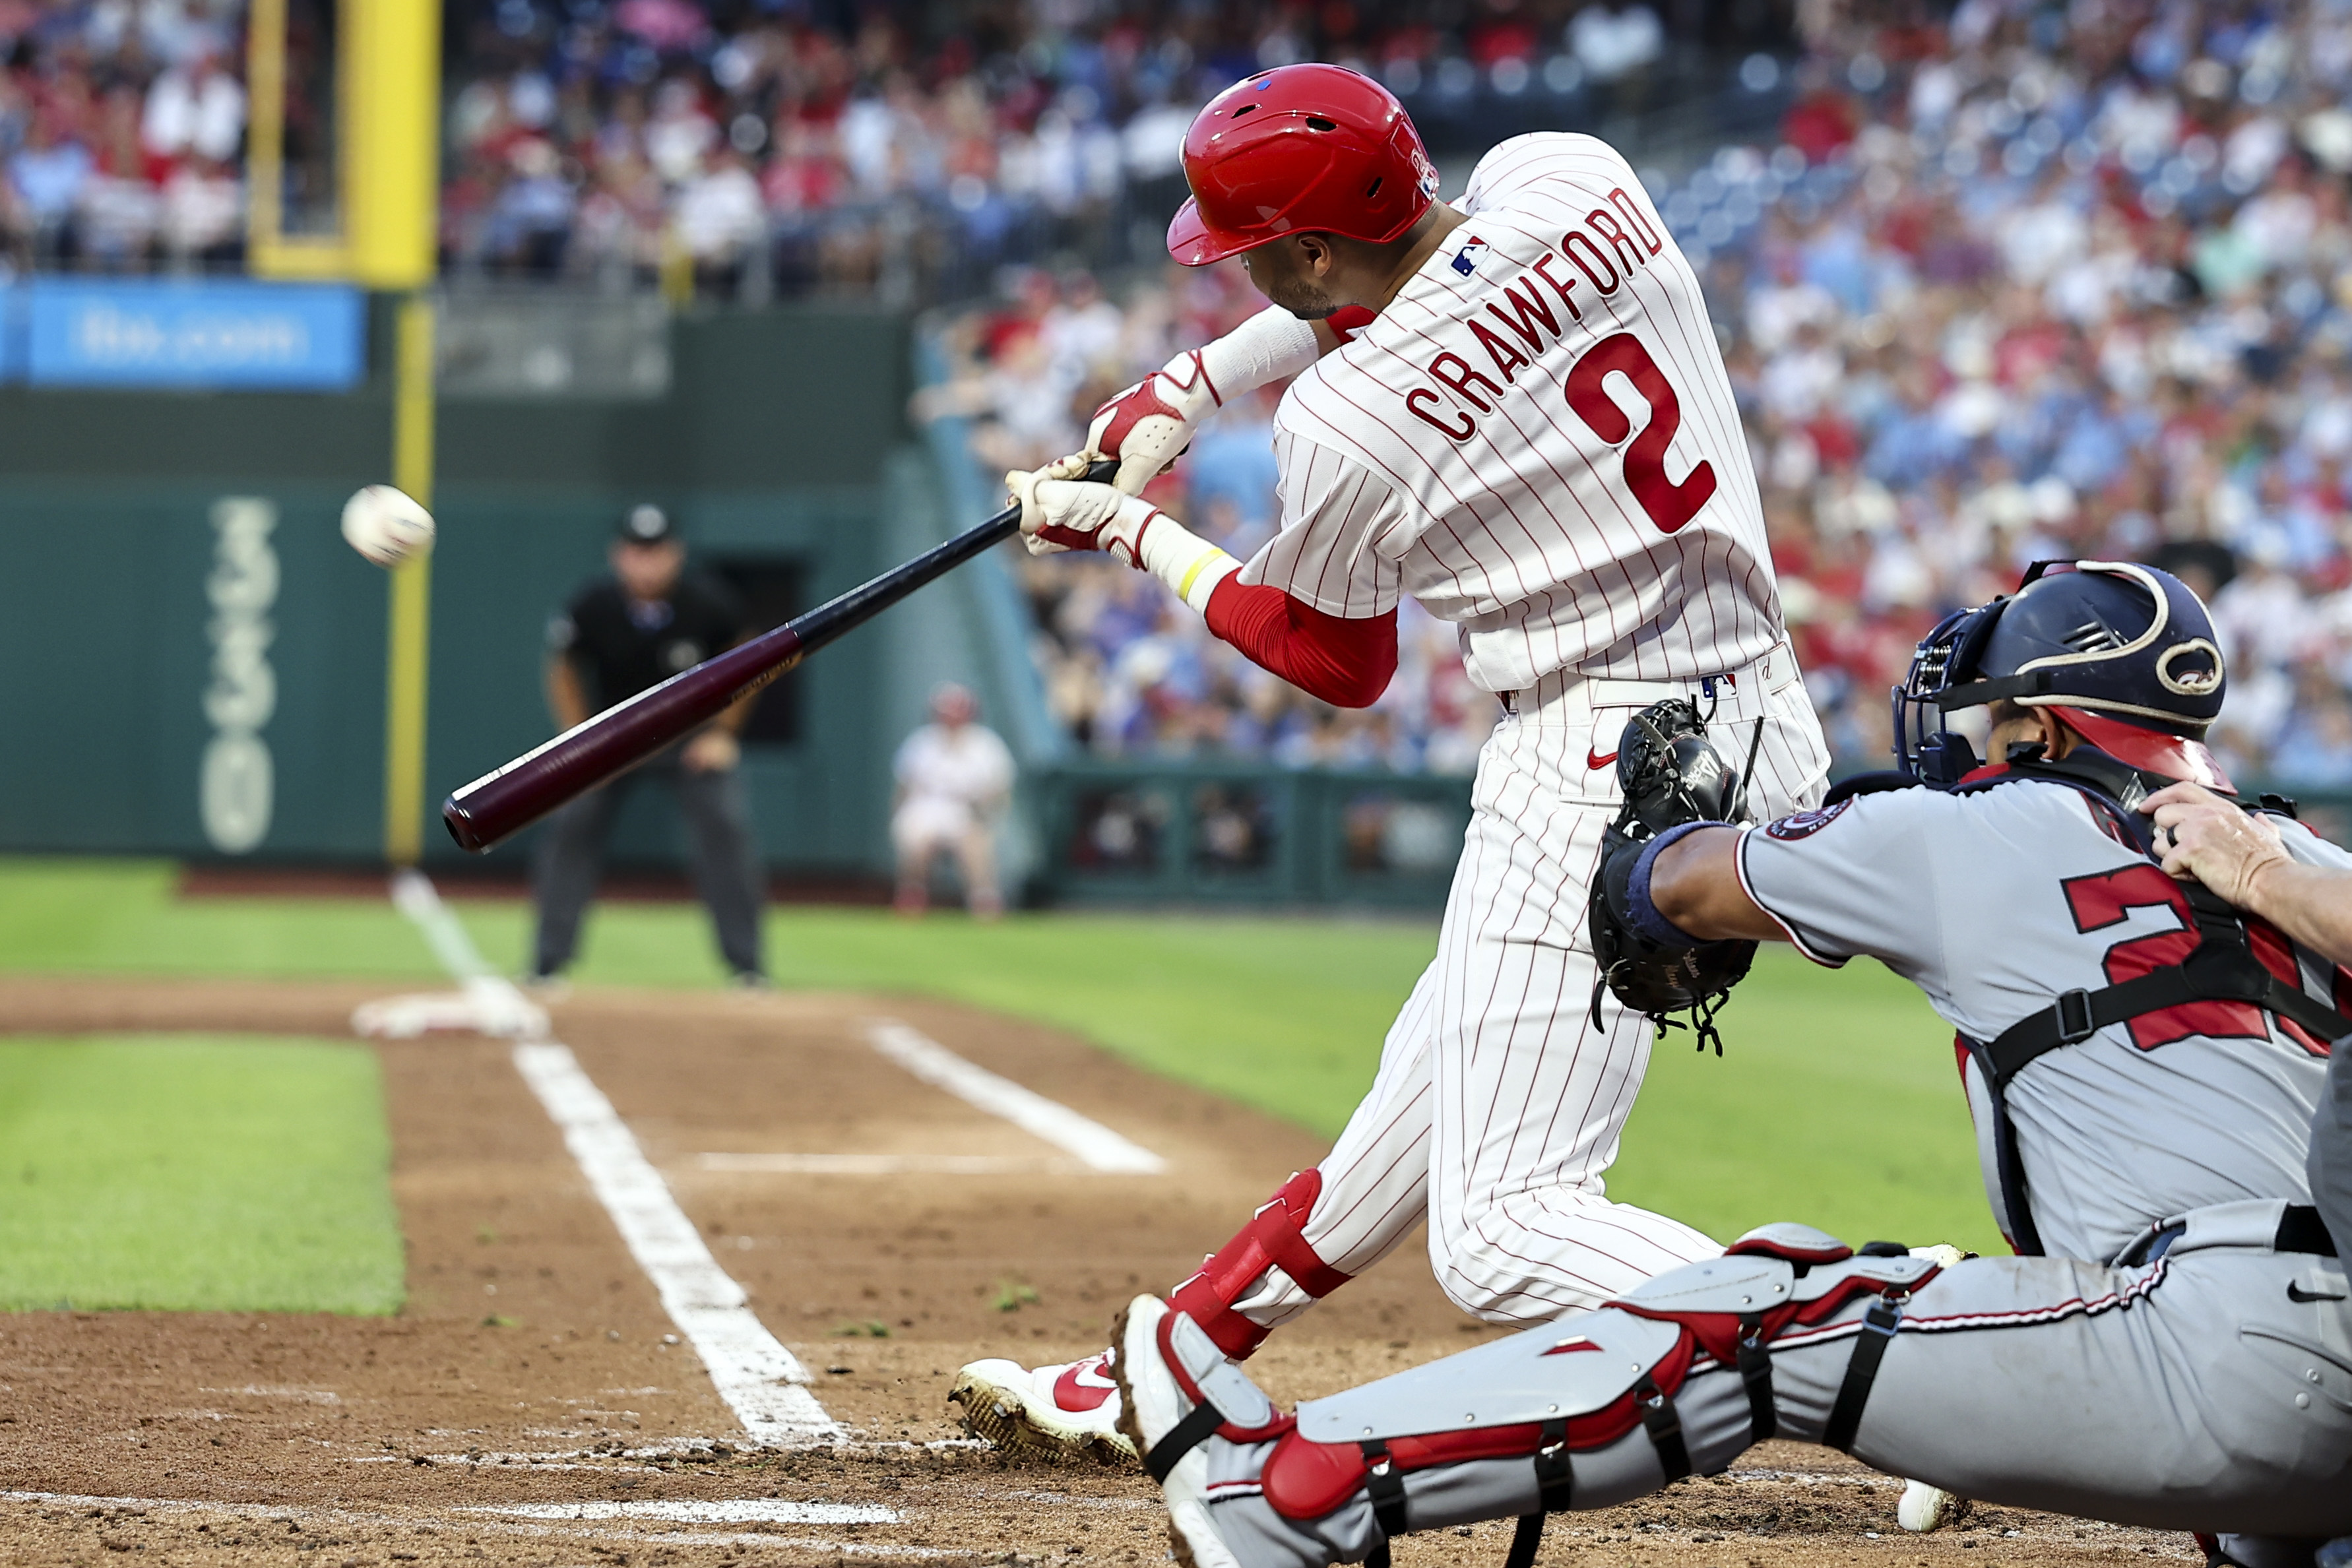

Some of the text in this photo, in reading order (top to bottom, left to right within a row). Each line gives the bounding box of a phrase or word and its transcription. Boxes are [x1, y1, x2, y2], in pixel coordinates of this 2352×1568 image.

[1405, 187, 1663, 442] CRAWFORD
[1564, 332, 1717, 534] 2
[203, 496, 281, 852] 330
